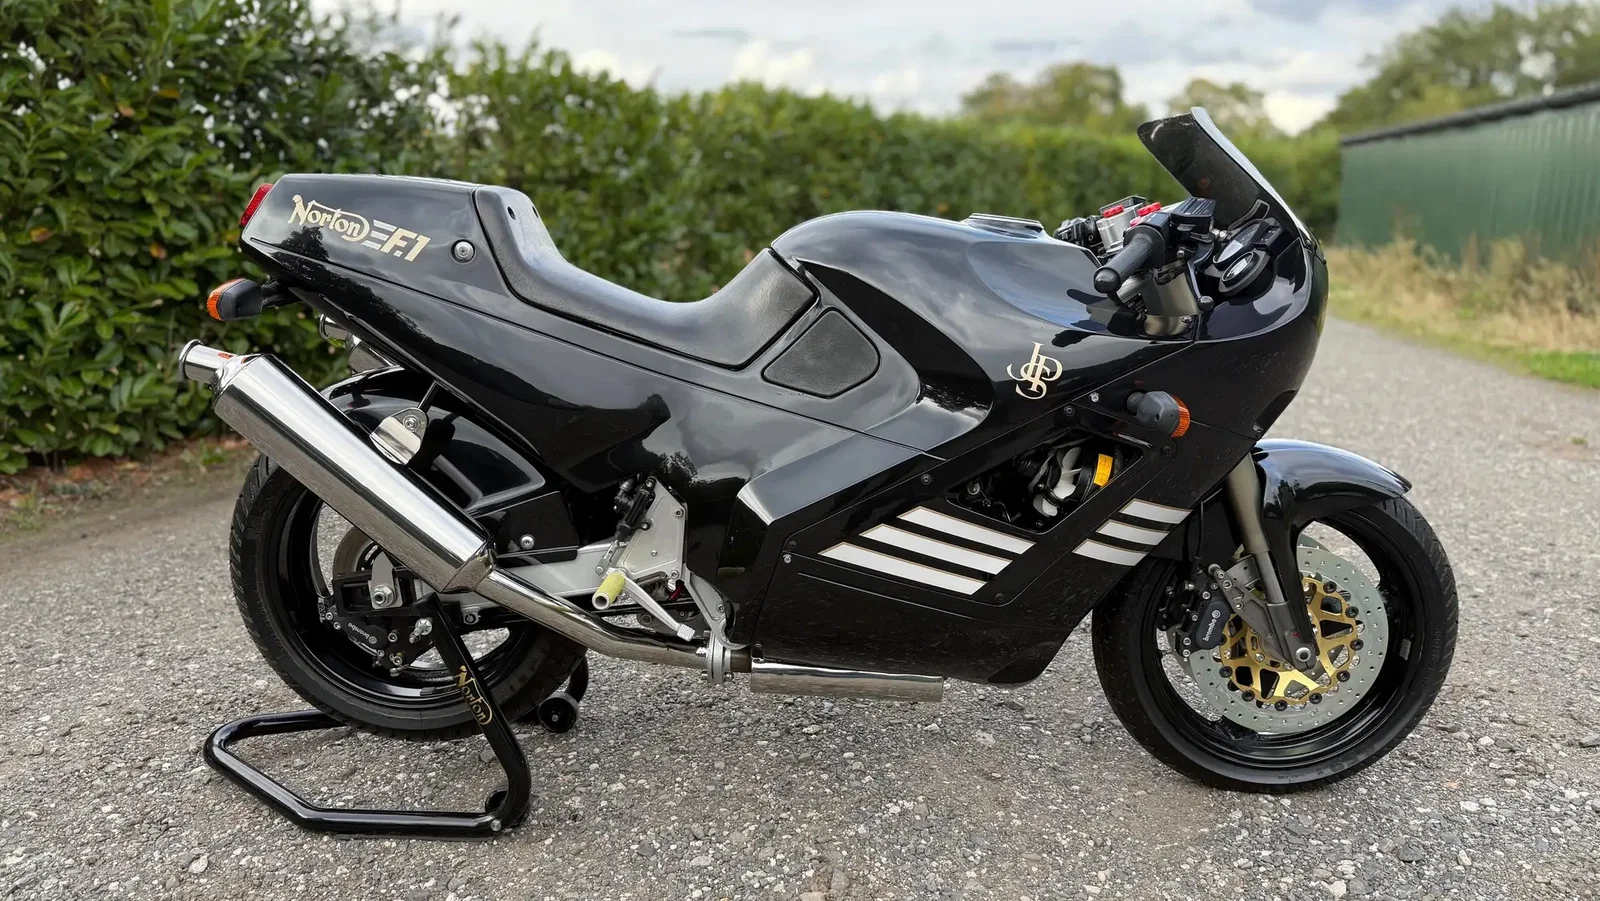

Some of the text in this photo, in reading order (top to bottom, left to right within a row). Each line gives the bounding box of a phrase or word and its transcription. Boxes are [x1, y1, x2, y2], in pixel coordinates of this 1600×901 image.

[288, 194, 370, 242] Norton
[1202, 618, 1217, 642] brembo
[453, 665, 493, 726] Norton
